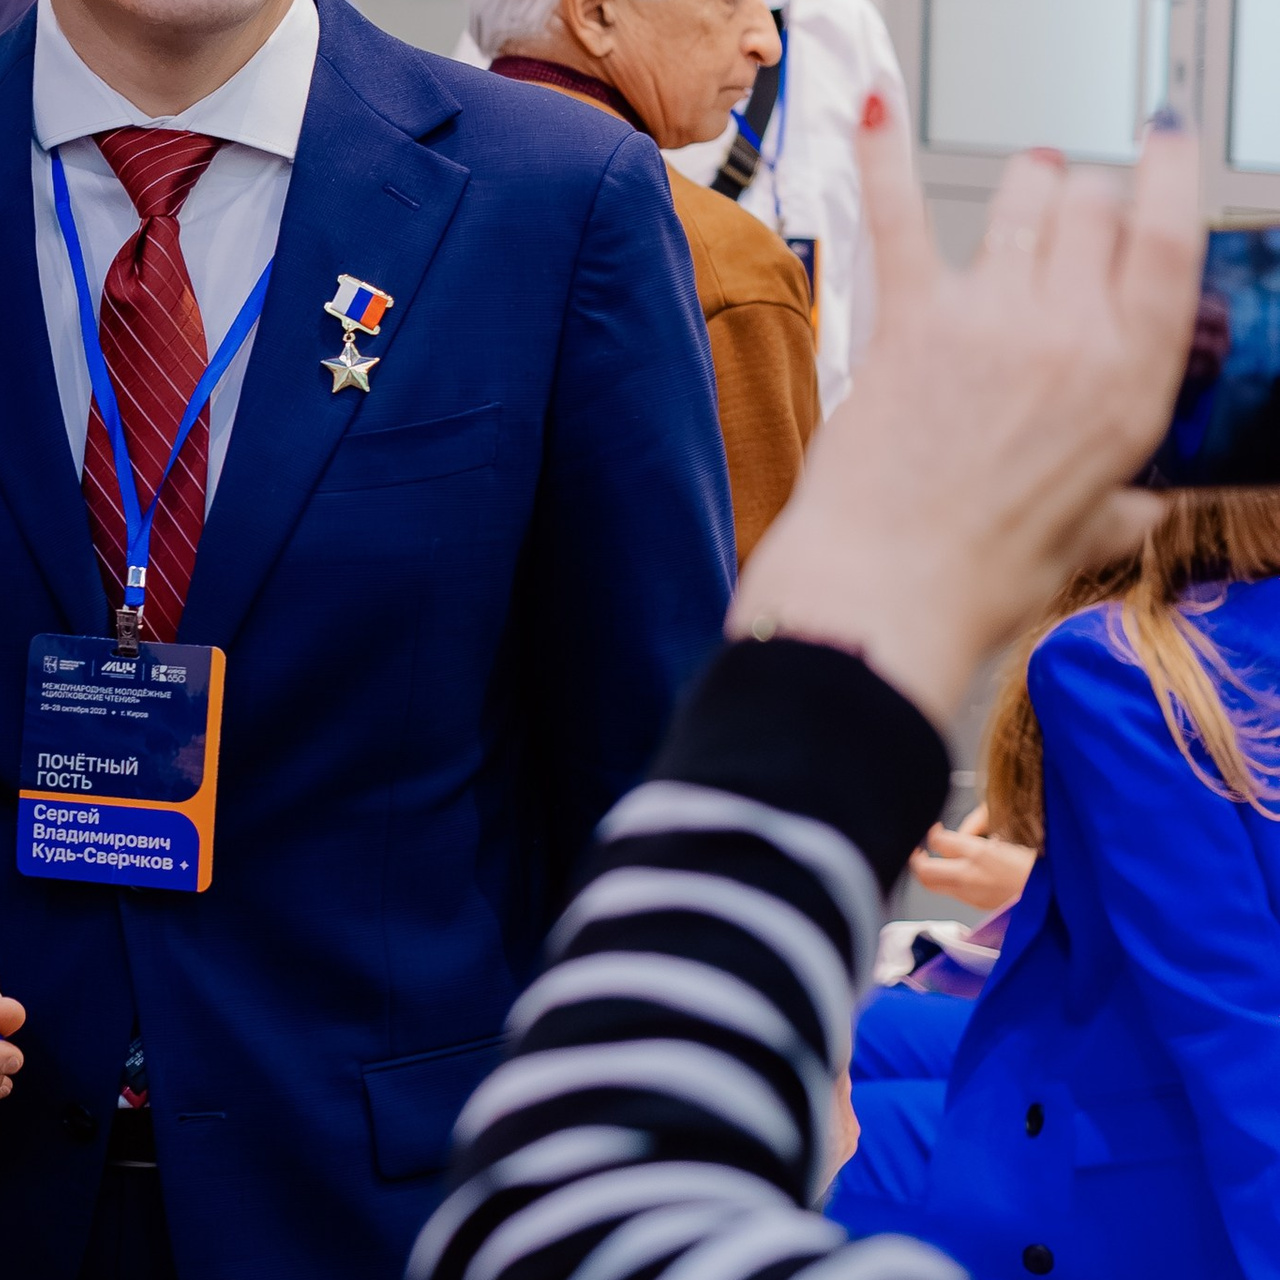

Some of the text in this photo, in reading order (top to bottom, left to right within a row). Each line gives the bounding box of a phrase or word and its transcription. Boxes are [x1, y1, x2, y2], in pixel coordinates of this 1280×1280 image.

[42, 682, 172, 699] МЕЖДУНАРОДНЫЕ МОЛОДЁЖНЫЕ
[89, 707, 107, 715] 2023
[37, 752, 139, 776] ПОЧЁТНЫЙ
[36, 771, 93, 790] ГОСТЬ
[33, 804, 100, 825] Сергей
[32, 822, 171, 851] Владимирович
[31, 842, 174, 871] Кудь-Сверчков
